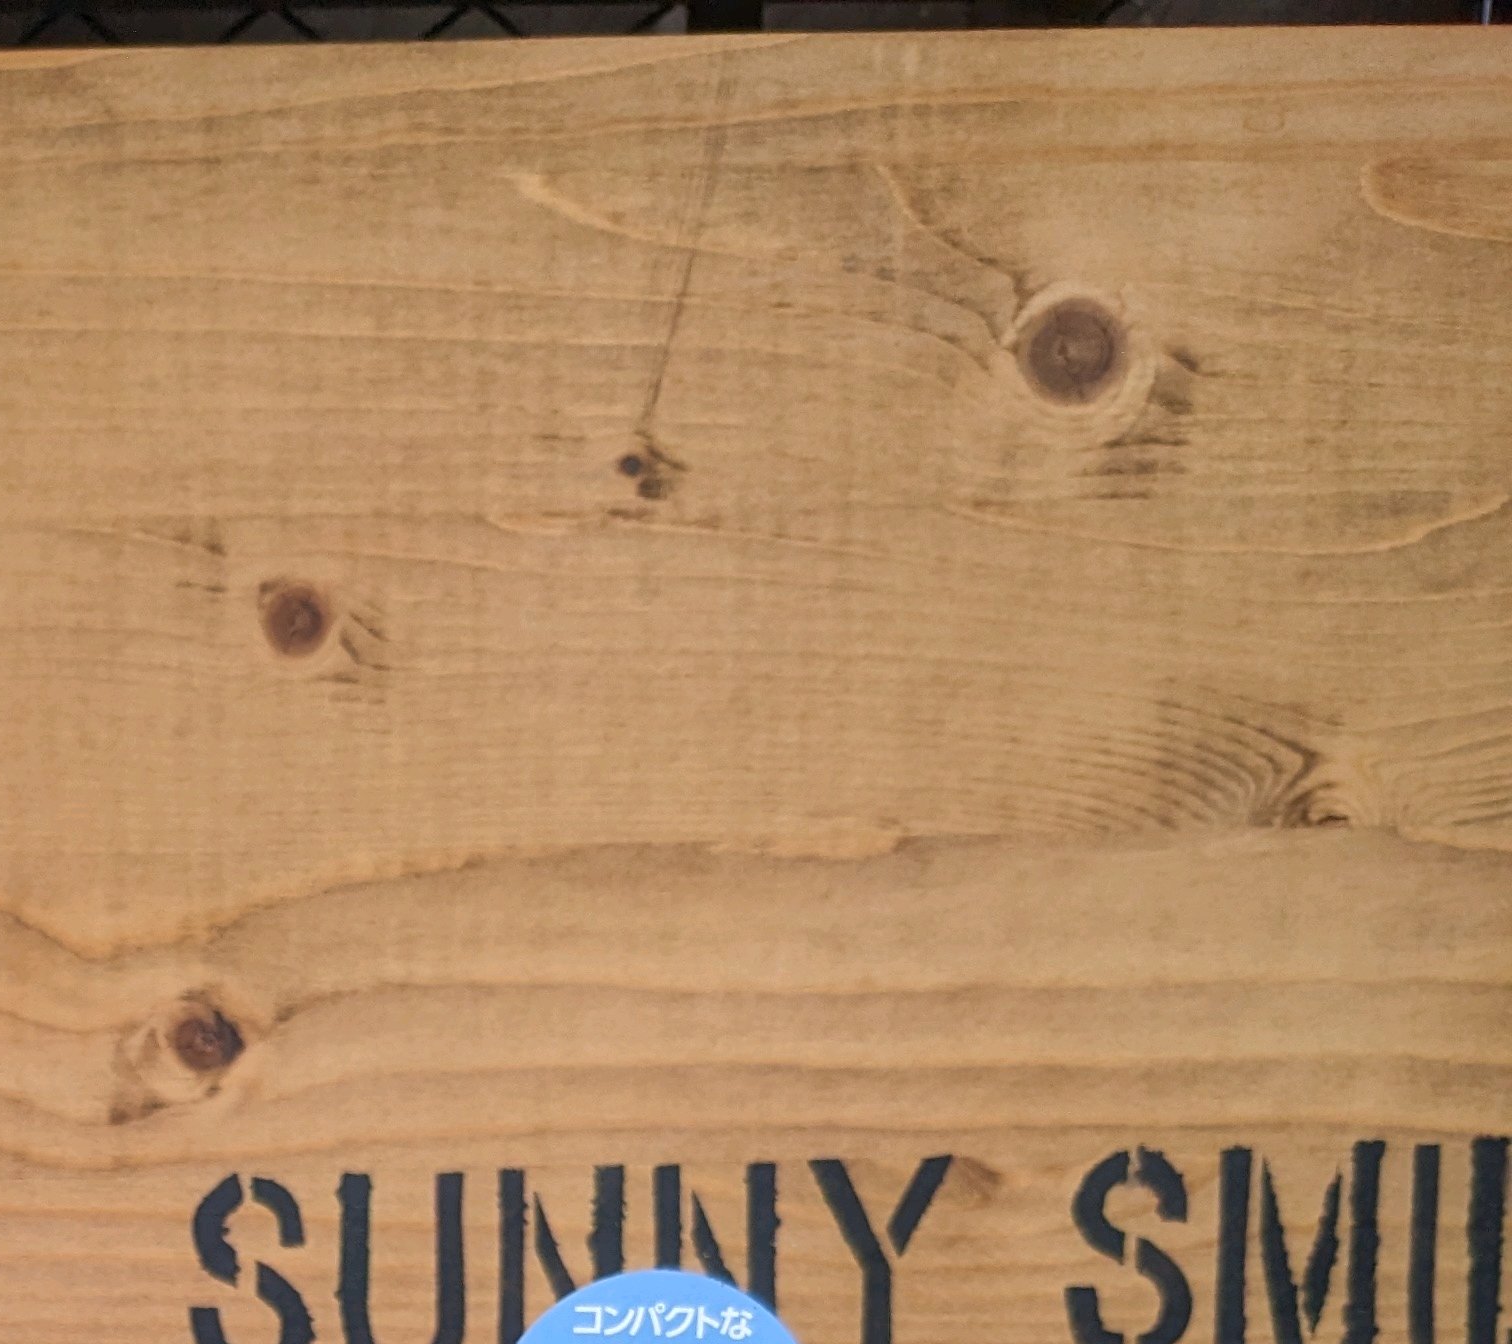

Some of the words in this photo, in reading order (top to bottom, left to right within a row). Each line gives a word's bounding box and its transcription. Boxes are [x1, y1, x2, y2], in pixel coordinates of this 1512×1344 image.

[572, 1303, 754, 1341] コンパクトな
